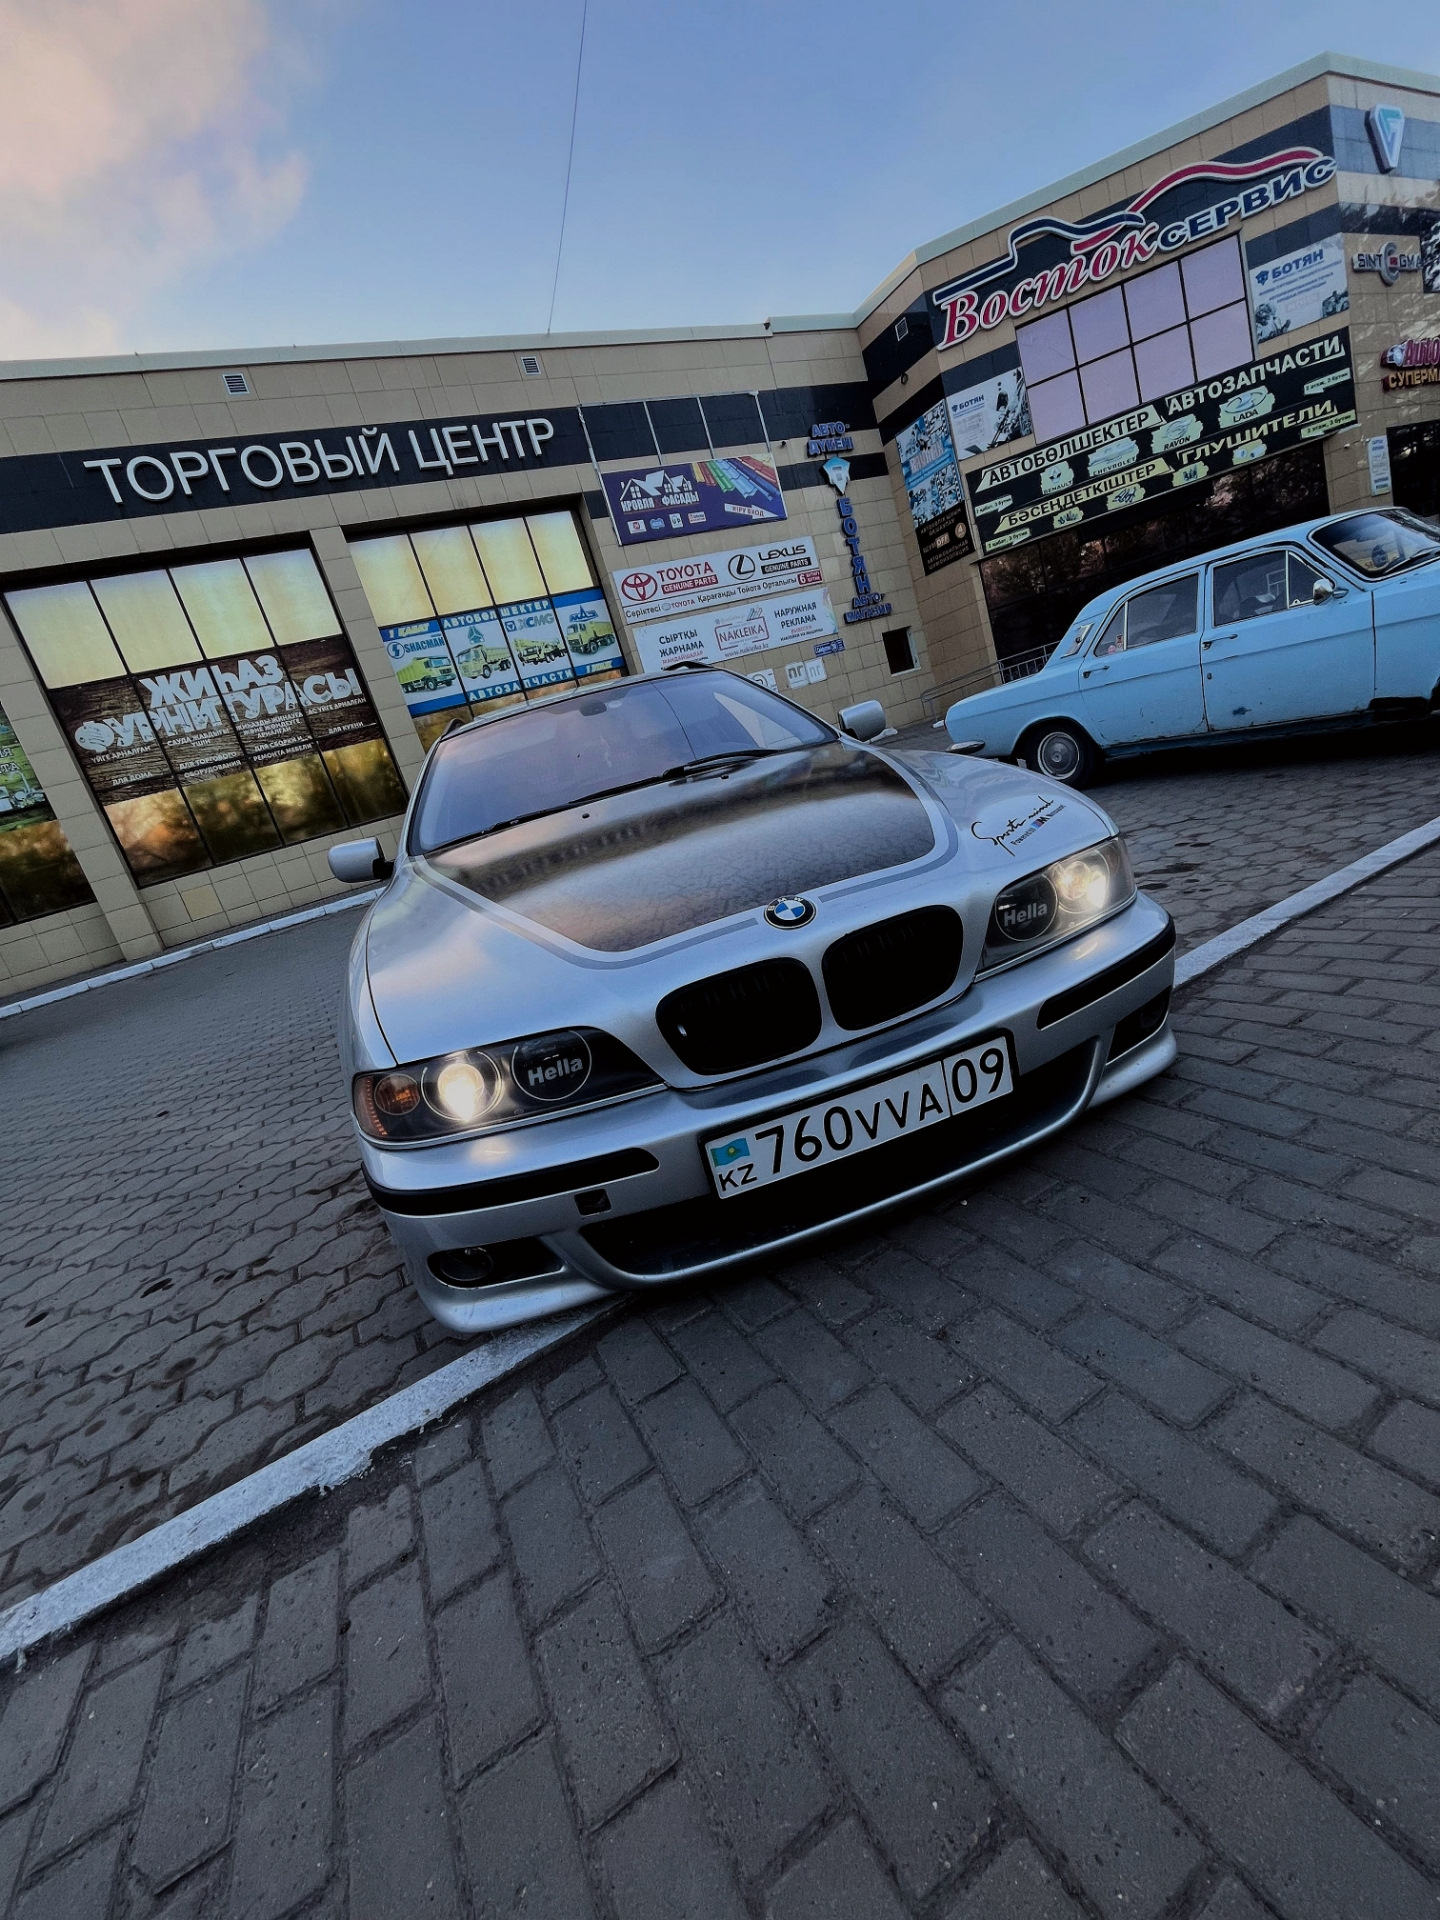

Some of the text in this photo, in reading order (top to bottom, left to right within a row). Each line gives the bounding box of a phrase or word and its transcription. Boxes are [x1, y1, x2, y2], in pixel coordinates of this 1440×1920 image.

[1271, 248, 1324, 280] БОТЯН
[1168, 335, 1340, 416] АВТОЗАПЧАСТИ
[1389, 368, 1440, 388] СУПЕРМ
[959, 394, 985, 410] БОТЯН
[1233, 410, 1259, 423] LADA
[1181, 400, 1332, 464] ГЛУШИТЕЛИ
[989, 411, 1149, 486] АВТОБӨЛШЕКТЕР
[1164, 435, 1191, 450] RAVON
[83, 417, 555, 504] ТОРГОВЫЙ ЦЕНТР
[1093, 457, 1137, 477] CHEVROLET
[1009, 464, 1156, 527] БӘСЕҢДЕТКІШТЕР
[1044, 480, 1072, 495] RENAULT
[620, 497, 655, 513] КРОВЛЯ
[661, 490, 700, 506] ФАСАДЫ
[758, 544, 806, 561] LEXUS
[838, 498, 871, 594] БОТЯН
[656, 561, 714, 582] TOYOTA
[763, 558, 809, 573] GENUINE PARTS
[663, 575, 717, 592] GENUINE PARTS
[799, 573, 807, 585] 6
[625, 576, 797, 619] Серіктесі TOYOTA Қарағанды Тойота Орталығы
[774, 602, 817, 618] НАРУЖНАЯ
[845, 603, 892, 623] МАГАЗИН
[517, 613, 555, 630] XCMG
[780, 613, 817, 628] РЕКЛАМА
[659, 628, 698, 645] СЫРТҚЫ
[718, 624, 765, 642] NAKLEIKA
[404, 637, 446, 653] SHACMAN
[659, 640, 705, 658] ЖАРНАМА
[788, 665, 804, 679] ПГ
[139, 655, 283, 709] ЖИҺАЗ
[469, 669, 574, 701] АВТОЗАПЧАСТИ
[75, 668, 363, 753] ФУРНИТУРАСЫ
[328, 720, 364, 735] ДЛЯ КУХНИ
[253, 743, 313, 762] РЕМОНТА МЕБЕЛИ
[254, 743, 270, 753] ДЛЯ
[269, 736, 296, 749] СБОРКИ
[179, 751, 237, 771] ДЛЯ ТОРГОВОГО
[184, 759, 242, 778] ОБОРУДОВАНИЯ
[112, 770, 153, 787] ДЛЯ ДОМА
[1003, 902, 1048, 928] Hella
[527, 1057, 584, 1087] Hella
[951, 1047, 1004, 1104] 09
[718, 1162, 757, 1192] KZ
